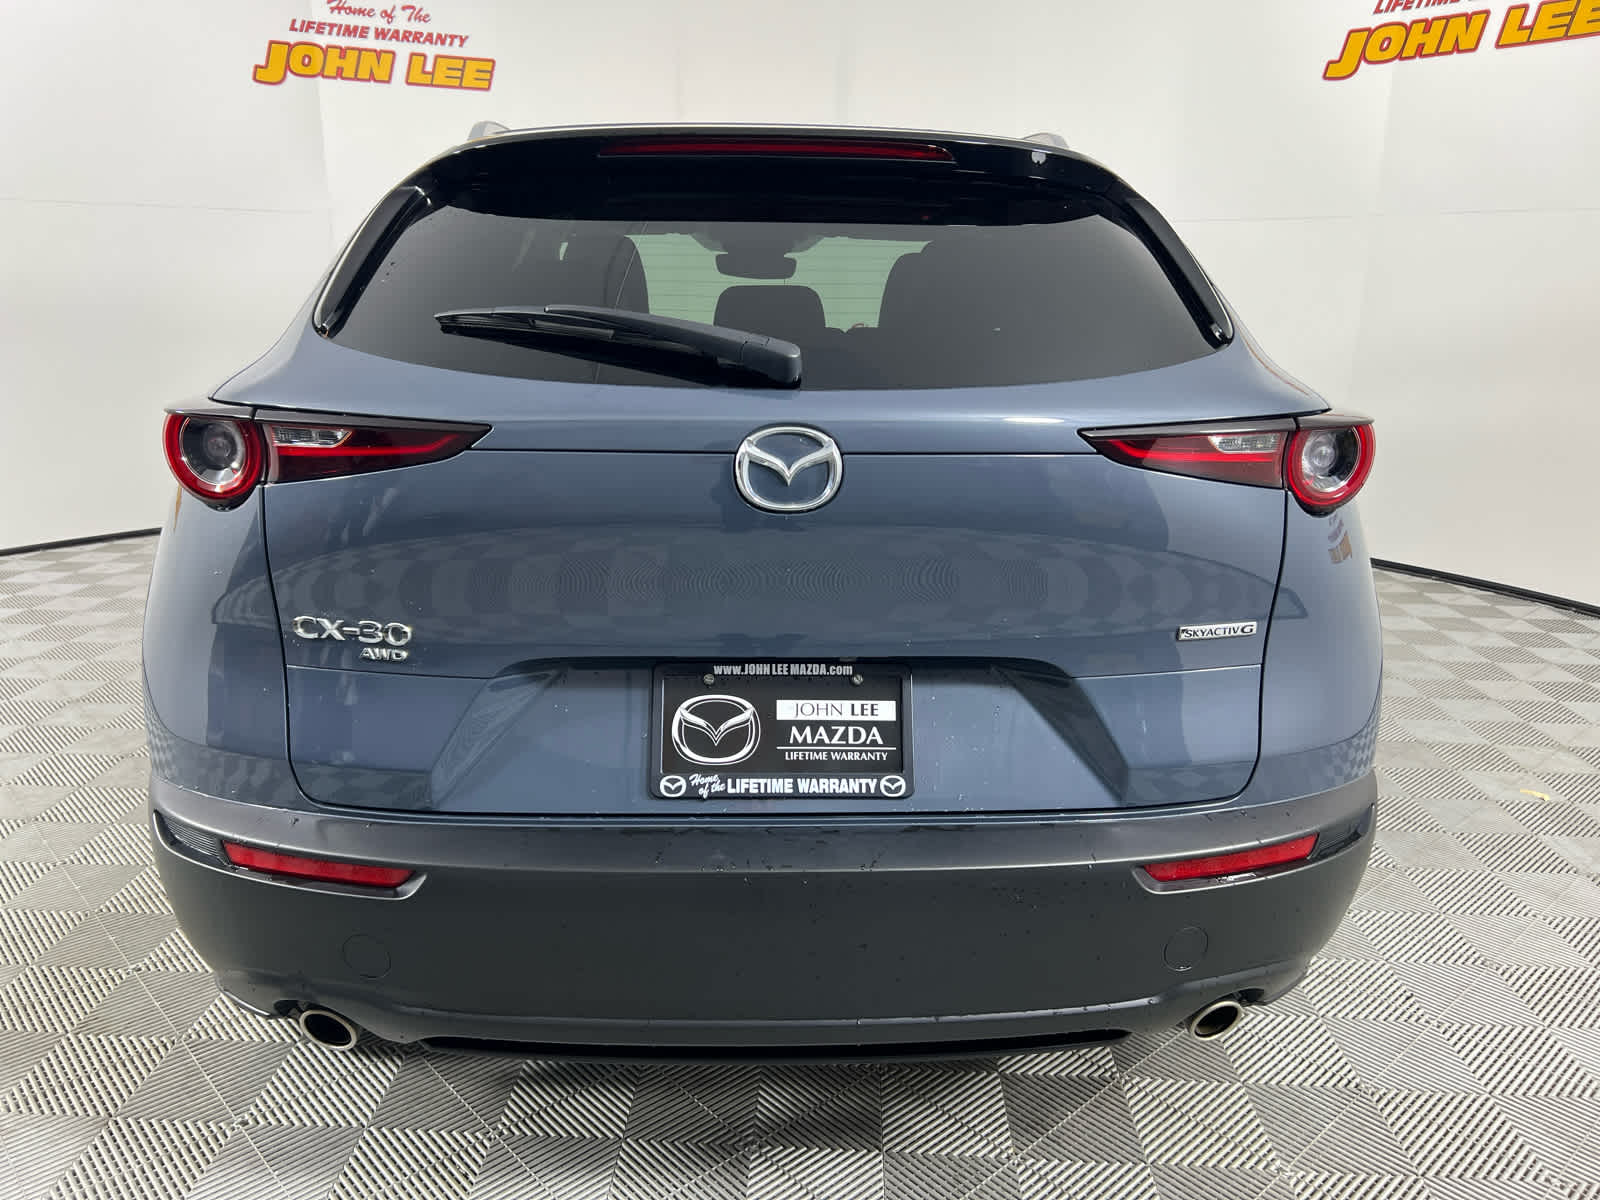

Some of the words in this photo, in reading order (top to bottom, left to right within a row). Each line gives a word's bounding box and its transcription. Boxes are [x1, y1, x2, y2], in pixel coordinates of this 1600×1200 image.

[327, 0, 375, 17] Home
[380, 4, 396, 24] of
[401, 4, 431, 23] The
[1373, 0, 1460, 14] LIFE
[289, 19, 369, 39] LIFETIME
[374, 28, 469, 48] WARRANTY
[1322, 9, 1491, 81] JOHN
[253, 40, 396, 85] JOHN
[405, 52, 496, 91] LEE
[293, 616, 412, 646] CX-30
[360, 647, 408, 661] AWD
[771, 663, 789, 676] LEE
[794, 702, 843, 718] JOHN
[850, 703, 879, 717] LEE
[789, 726, 884, 745] MAZDA
[785, 751, 828, 761] LIFETIME
[831, 752, 888, 761] WARRANTY
[689, 773, 720, 787] Home
[727, 778, 793, 793] LIFETIME
[798, 778, 878, 794] WARRANTY
[698, 783, 709, 799] of
[711, 780, 726, 793] the
